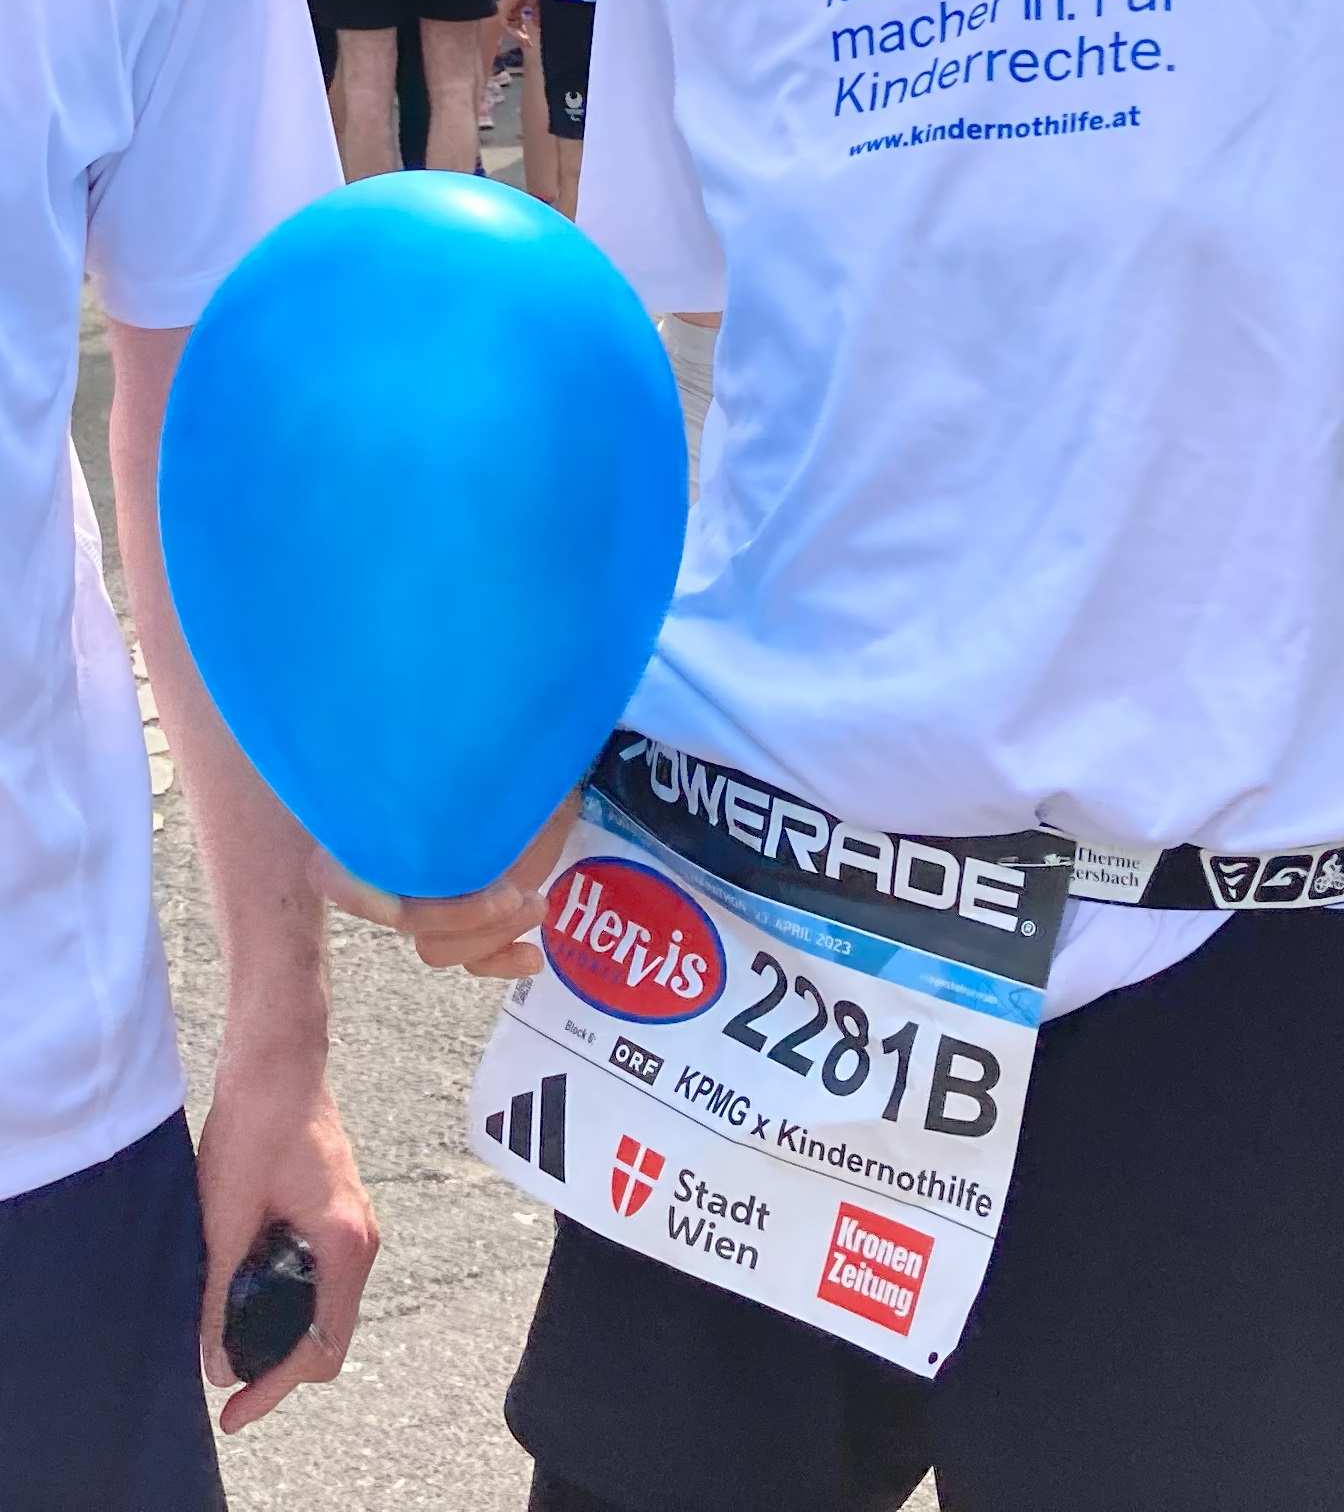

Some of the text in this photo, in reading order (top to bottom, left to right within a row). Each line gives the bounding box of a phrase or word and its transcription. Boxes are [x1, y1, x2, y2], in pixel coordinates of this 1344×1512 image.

[833, 31, 1176, 117] Kinderrechte.
[848, 104, 1142, 157] www.kindernothilfe.at
[554, 870, 709, 1001] Hervis
[815, 932, 852, 956] 2023
[615, 1043, 659, 1077] ORF
[720, 948, 1002, 1140] 2281B
[673, 1064, 994, 1218] KPMG x Kindernothilfe
[673, 1167, 772, 1232] Stadt
[667, 1205, 761, 1271] Wien
[838, 1214, 925, 1279] Kronen
[826, 1250, 915, 1317] Zeitung
